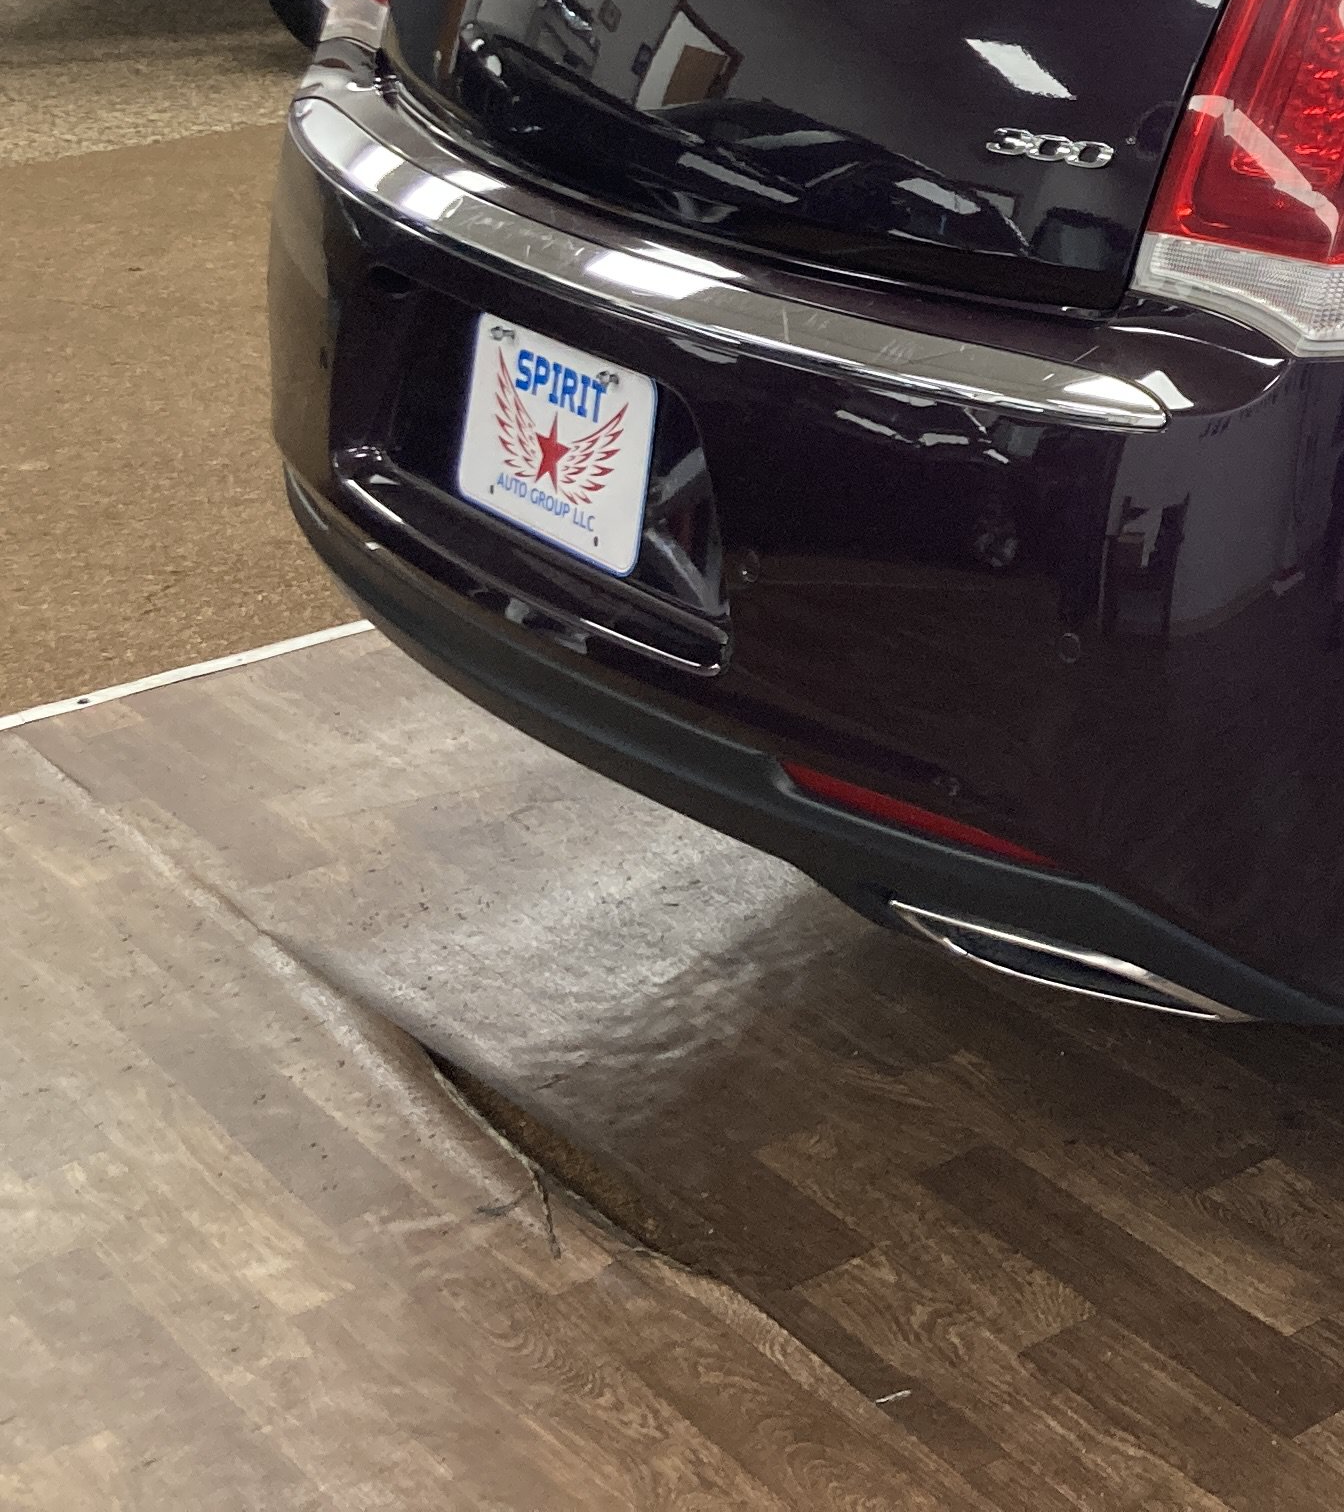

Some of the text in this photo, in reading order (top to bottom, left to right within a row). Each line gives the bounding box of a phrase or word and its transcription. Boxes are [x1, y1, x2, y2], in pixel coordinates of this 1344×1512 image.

[986, 127, 1114, 168] 300
[515, 349, 606, 423] SPIRIT
[496, 471, 597, 533] AUTO GROUP LLC
